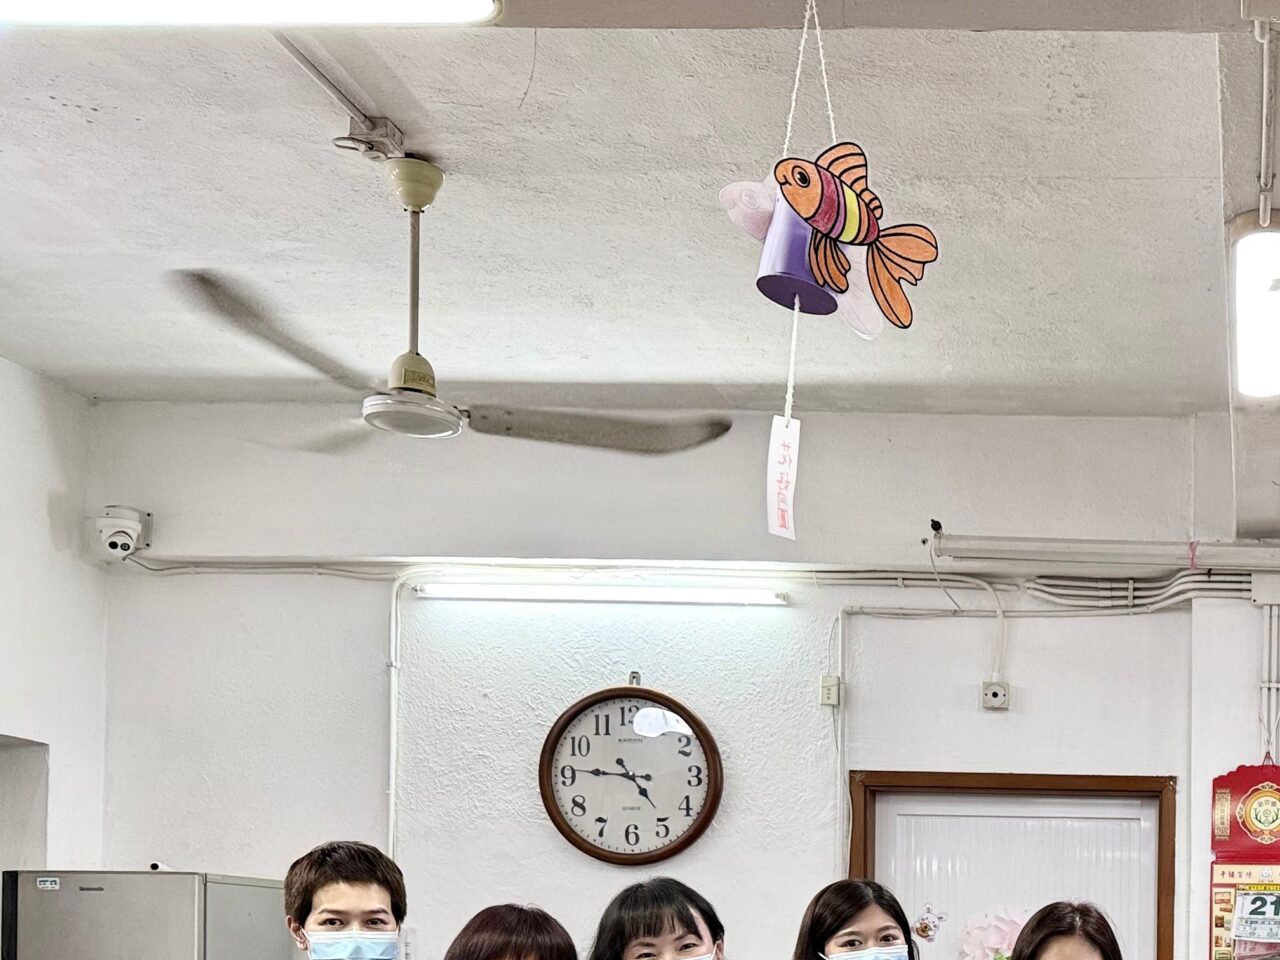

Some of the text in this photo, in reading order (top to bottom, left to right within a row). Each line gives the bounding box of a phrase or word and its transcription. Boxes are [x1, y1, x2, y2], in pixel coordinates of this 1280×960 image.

[593, 714, 611, 736] 11
[570, 734, 591, 757] 10
[677, 735, 692, 757] 2
[560, 764, 577, 787] 9
[687, 765, 703, 787] 3
[570, 794, 587, 817] 8
[677, 795, 694, 818] 4
[594, 816, 609, 838] 7
[624, 824, 640, 846] 6
[655, 816, 670, 838] 5
